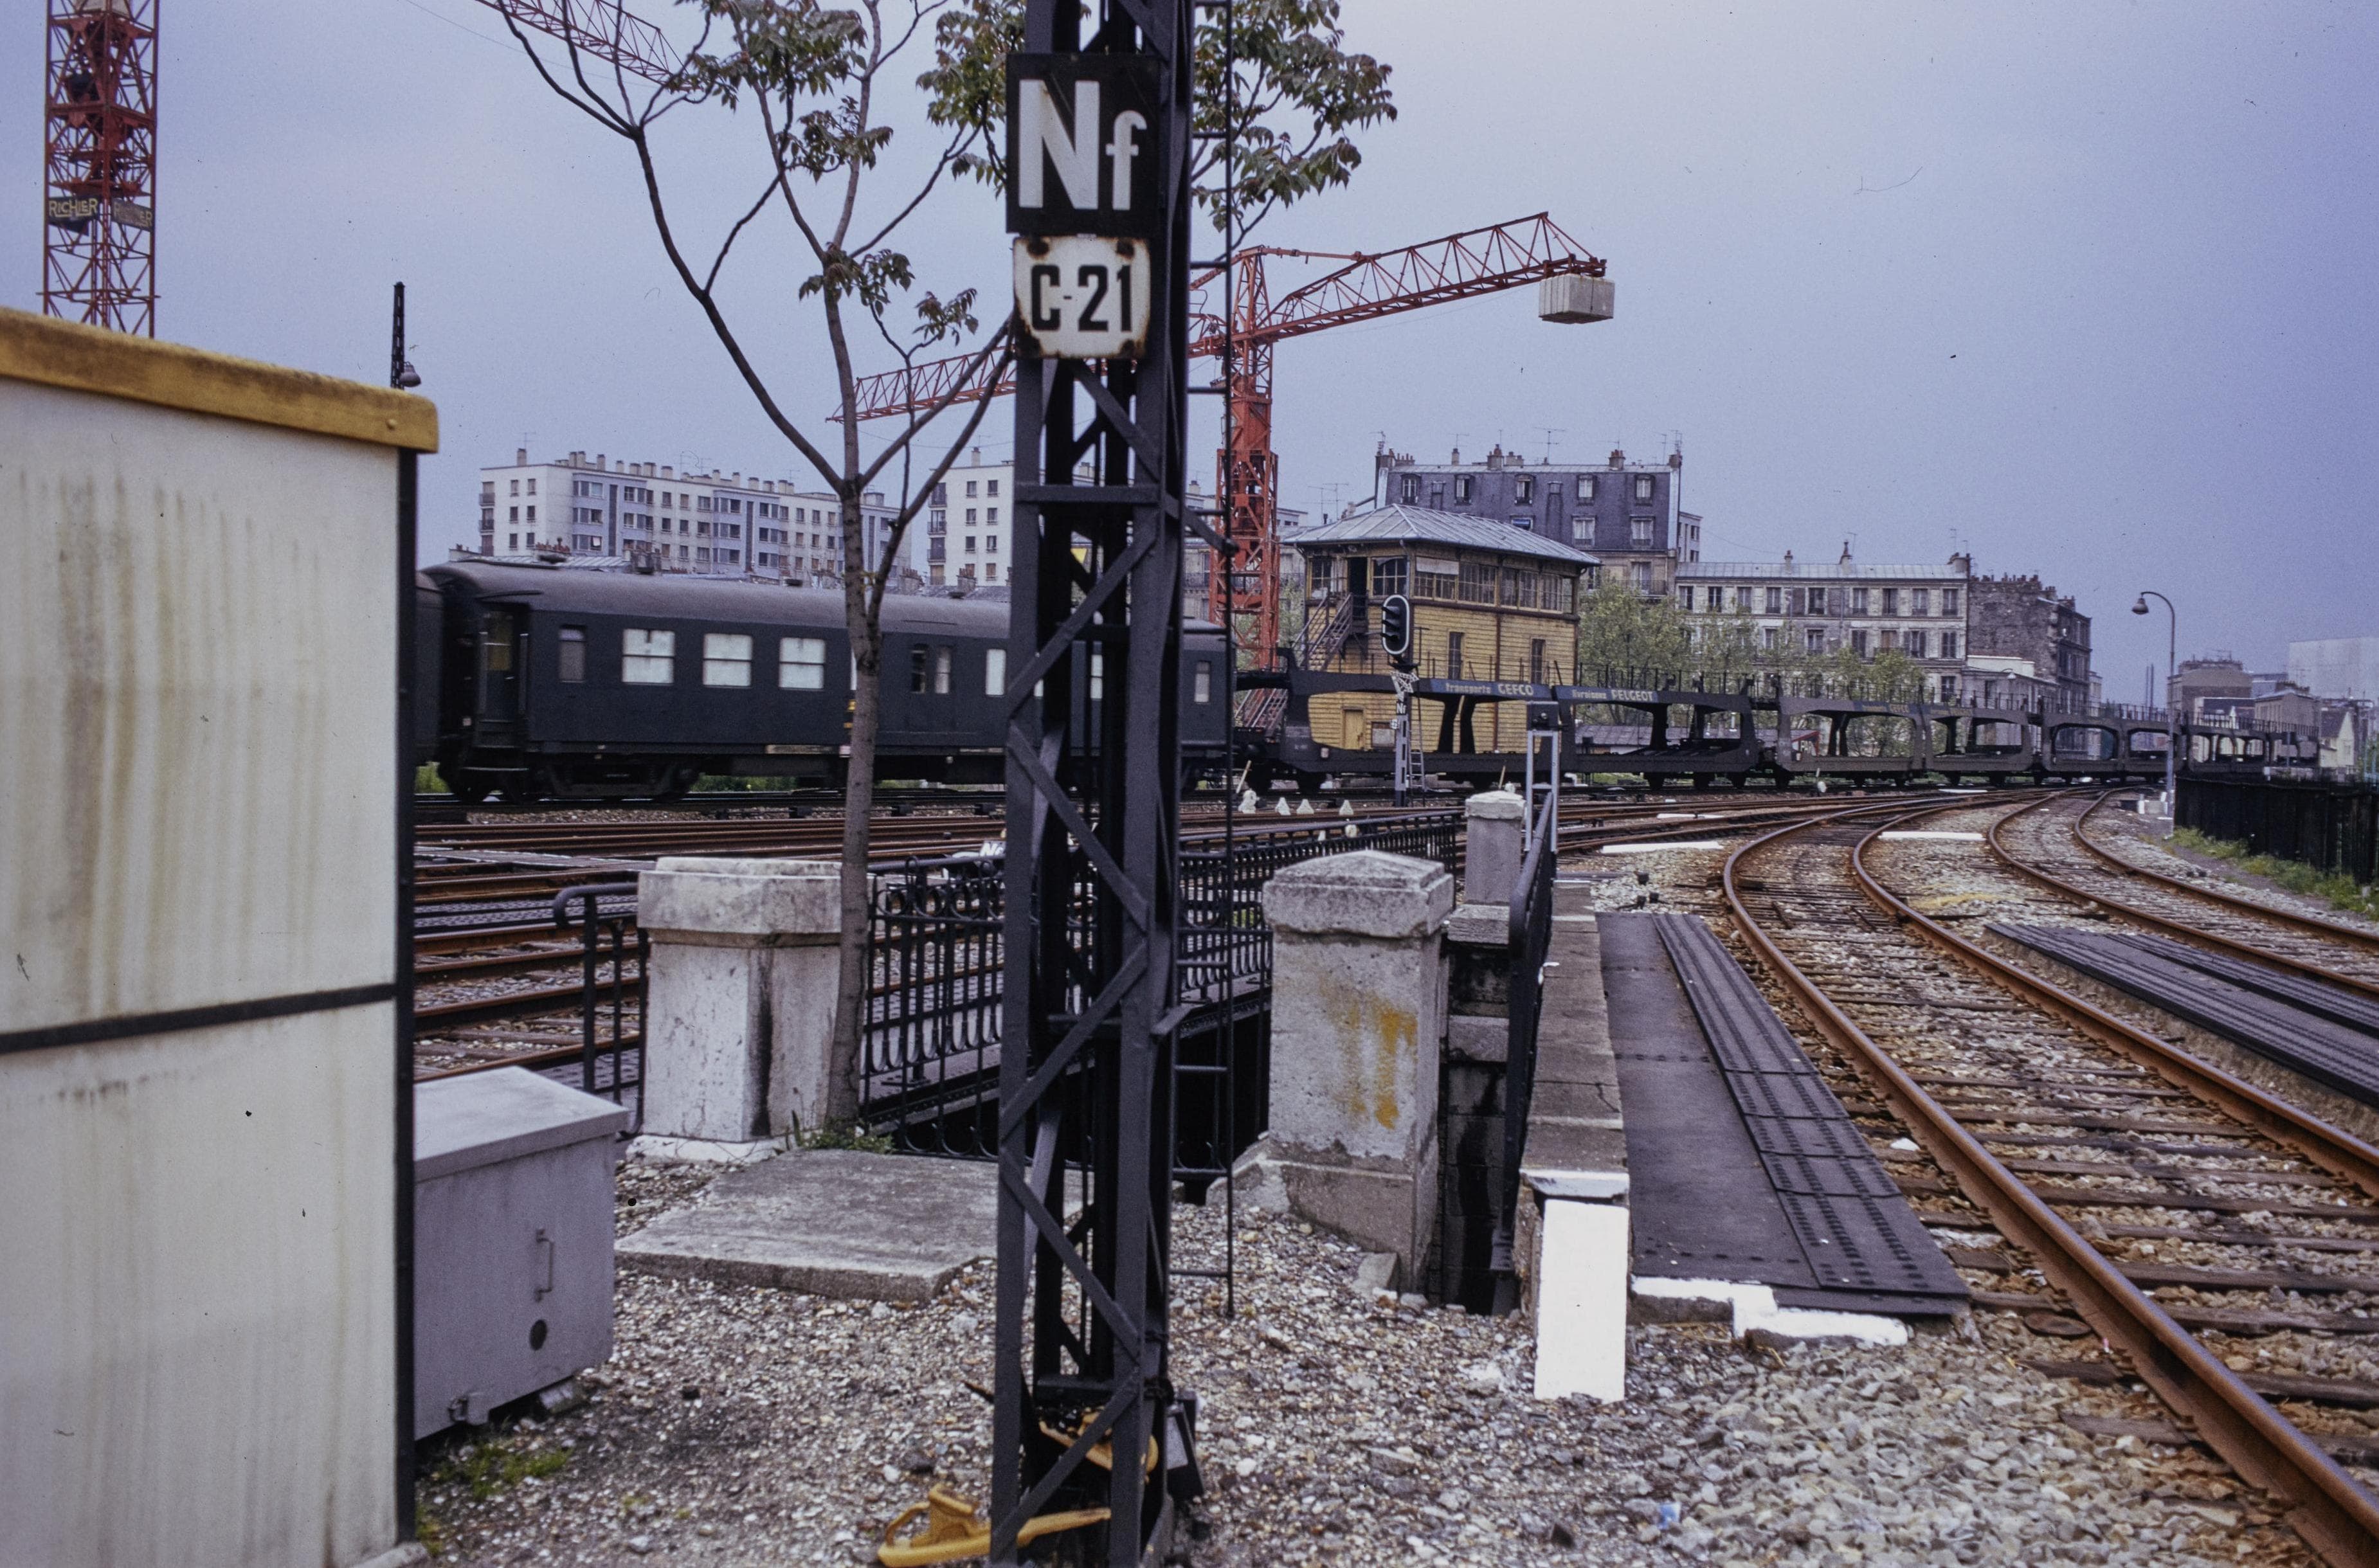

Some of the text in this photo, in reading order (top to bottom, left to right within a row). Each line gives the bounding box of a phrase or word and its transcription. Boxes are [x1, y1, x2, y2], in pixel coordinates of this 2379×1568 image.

[1018, 79, 1147, 211] Nf
[49, 198, 98, 217] RICHIER
[1031, 264, 1132, 332] C-21
[1497, 683, 1534, 696] GEFCO
[1611, 689, 1653, 701] PEUGEOT
